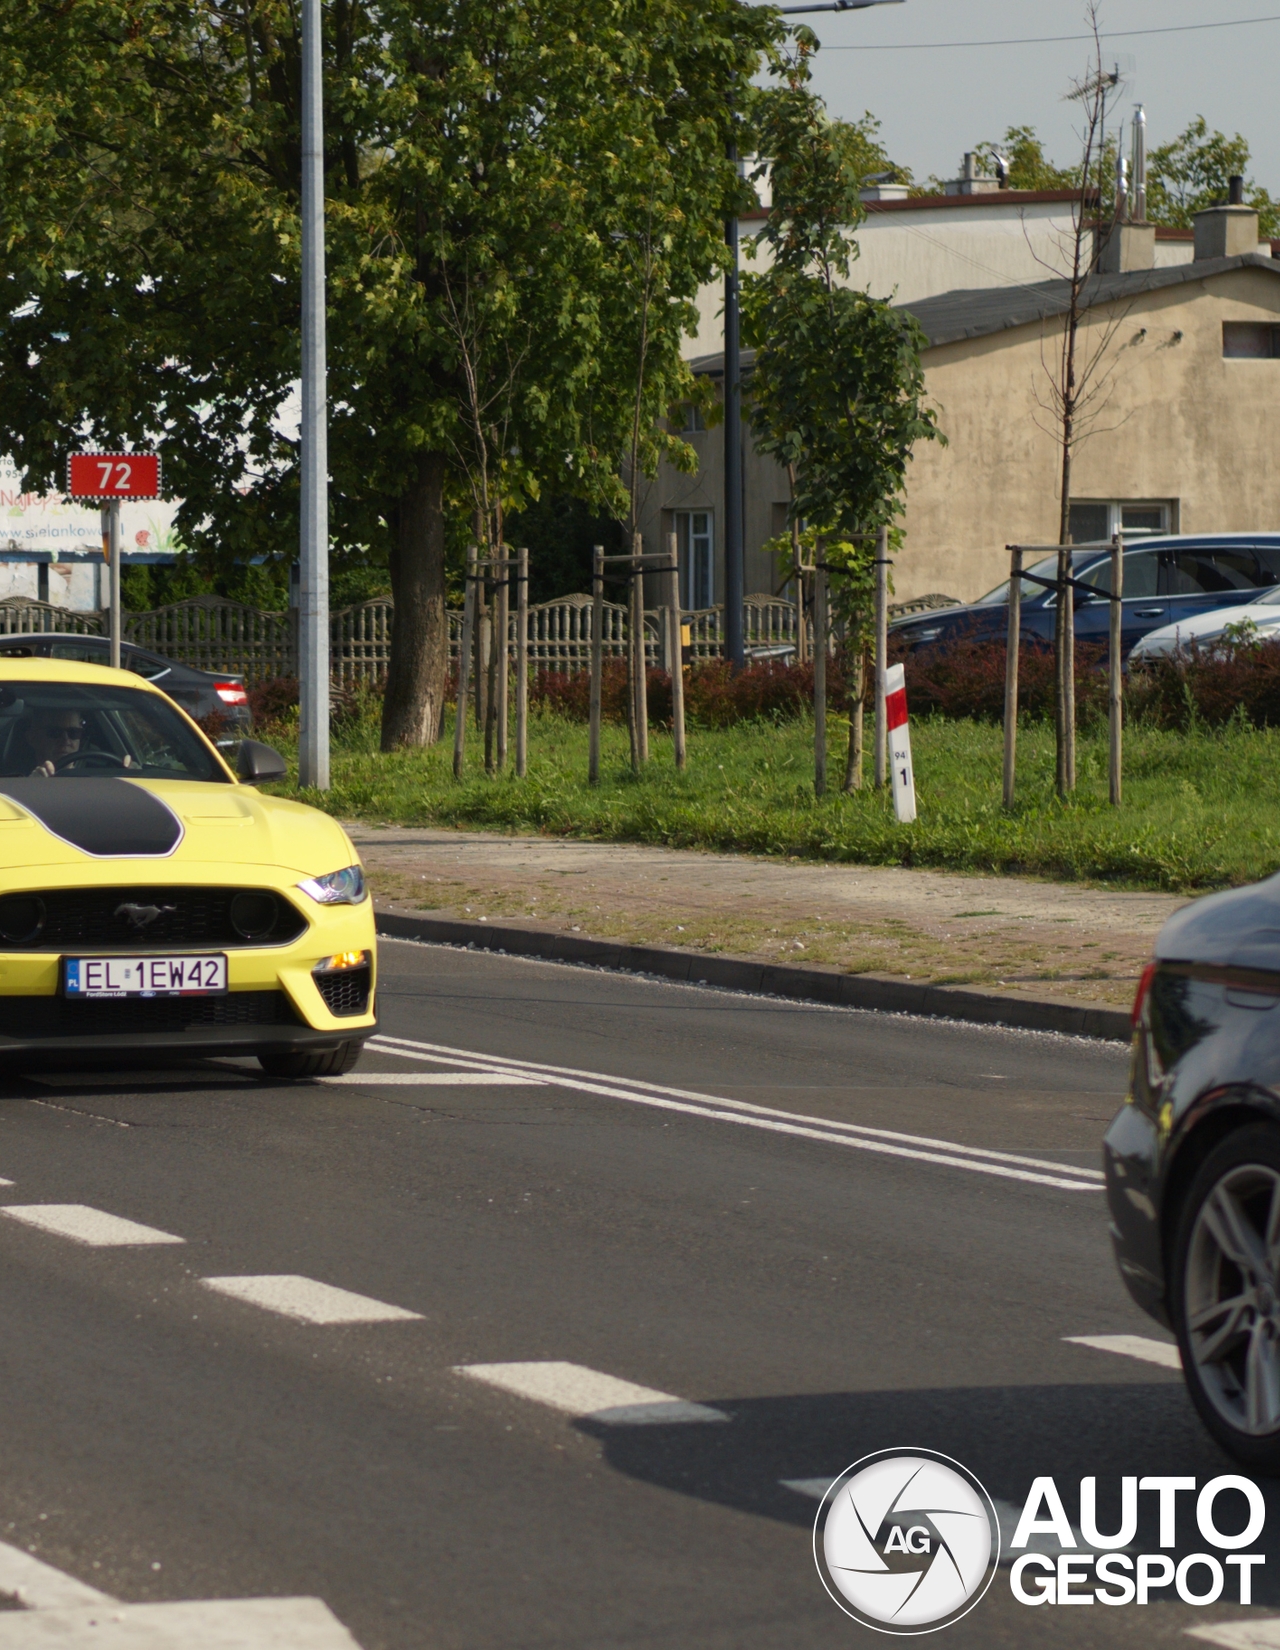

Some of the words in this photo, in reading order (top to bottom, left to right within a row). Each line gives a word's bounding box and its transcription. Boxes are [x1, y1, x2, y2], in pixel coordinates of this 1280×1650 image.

[97, 462, 132, 489] 72
[0, 489, 63, 512] Najleps
[895, 752, 905, 760] 94
[900, 768, 907, 786] 1
[68, 979, 79, 988] PL
[86, 962, 120, 989] EL
[135, 960, 219, 988] 1EW42
